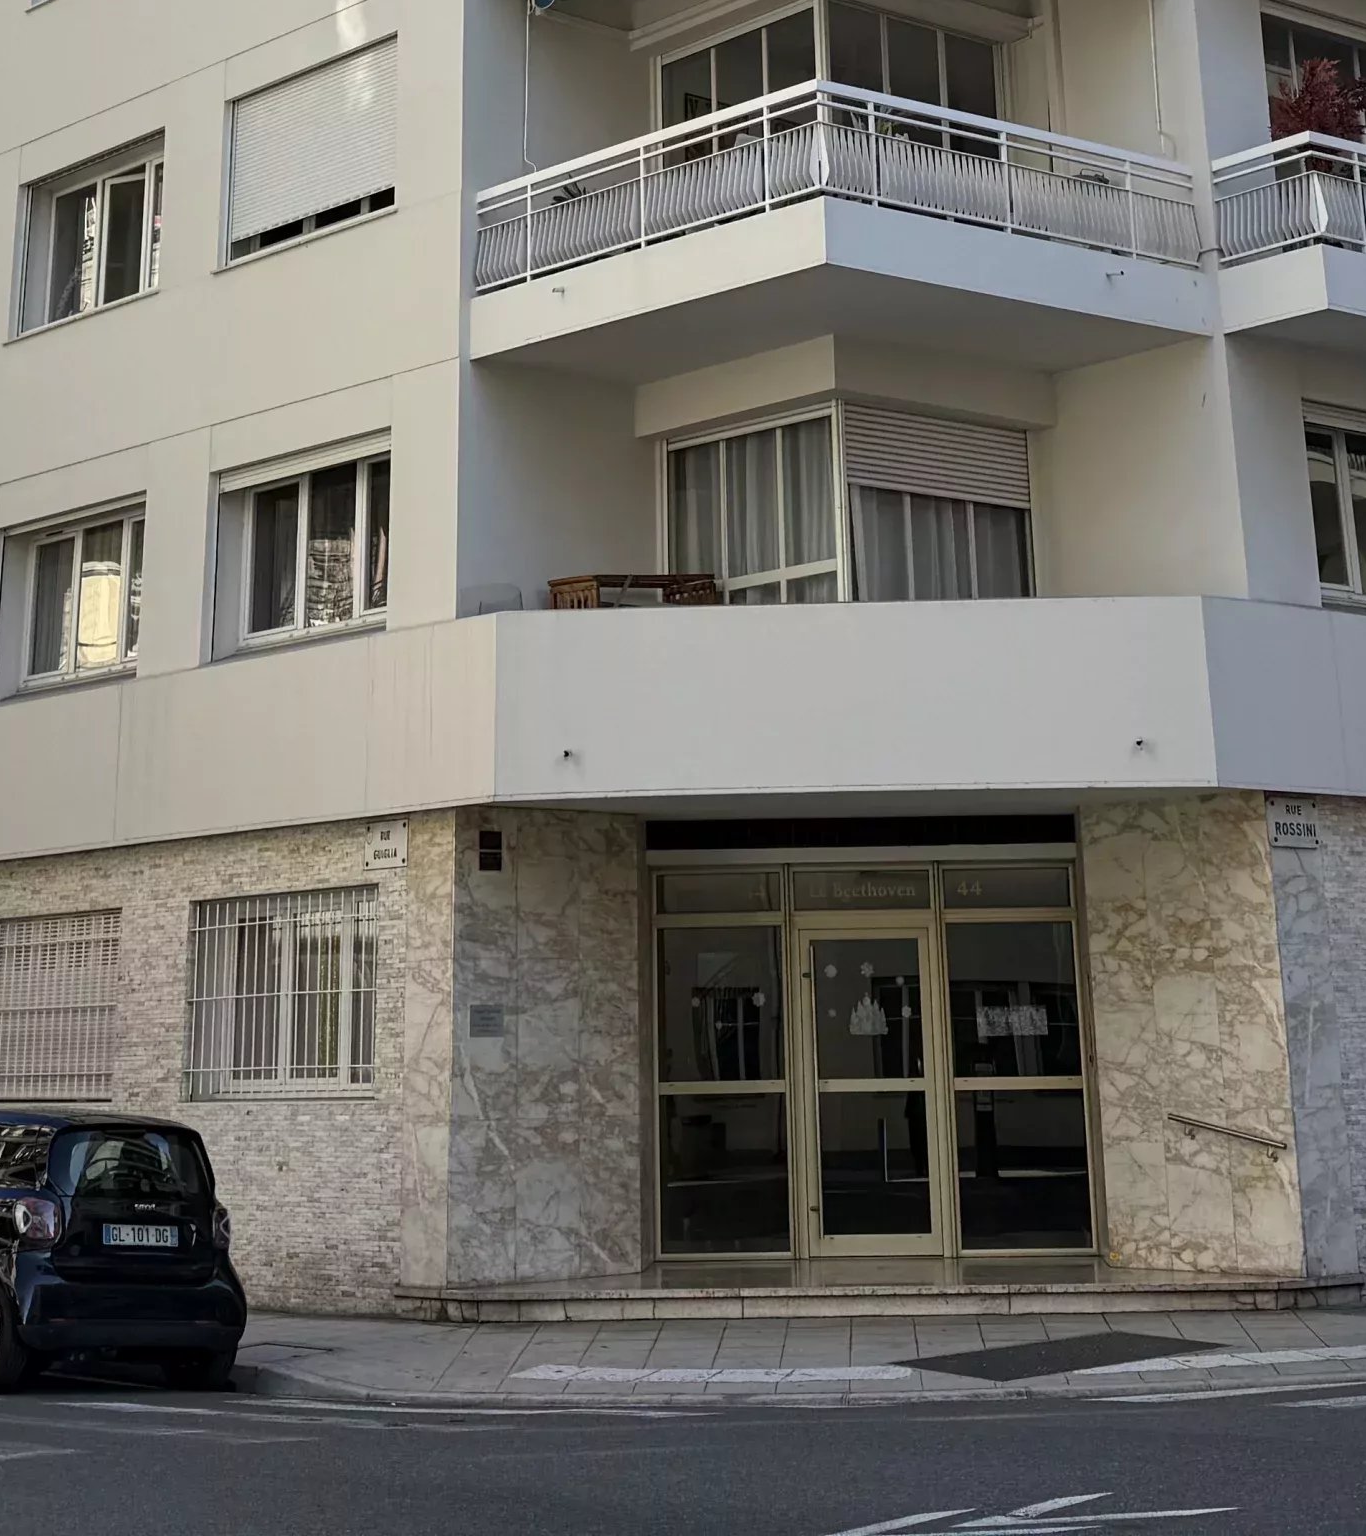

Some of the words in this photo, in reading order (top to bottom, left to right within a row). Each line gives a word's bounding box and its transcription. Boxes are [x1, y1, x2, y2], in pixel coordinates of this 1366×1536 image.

[1286, 804, 1302, 816] RUE
[1274, 821, 1317, 838] ROSSINI
[956, 879, 983, 897] 44
